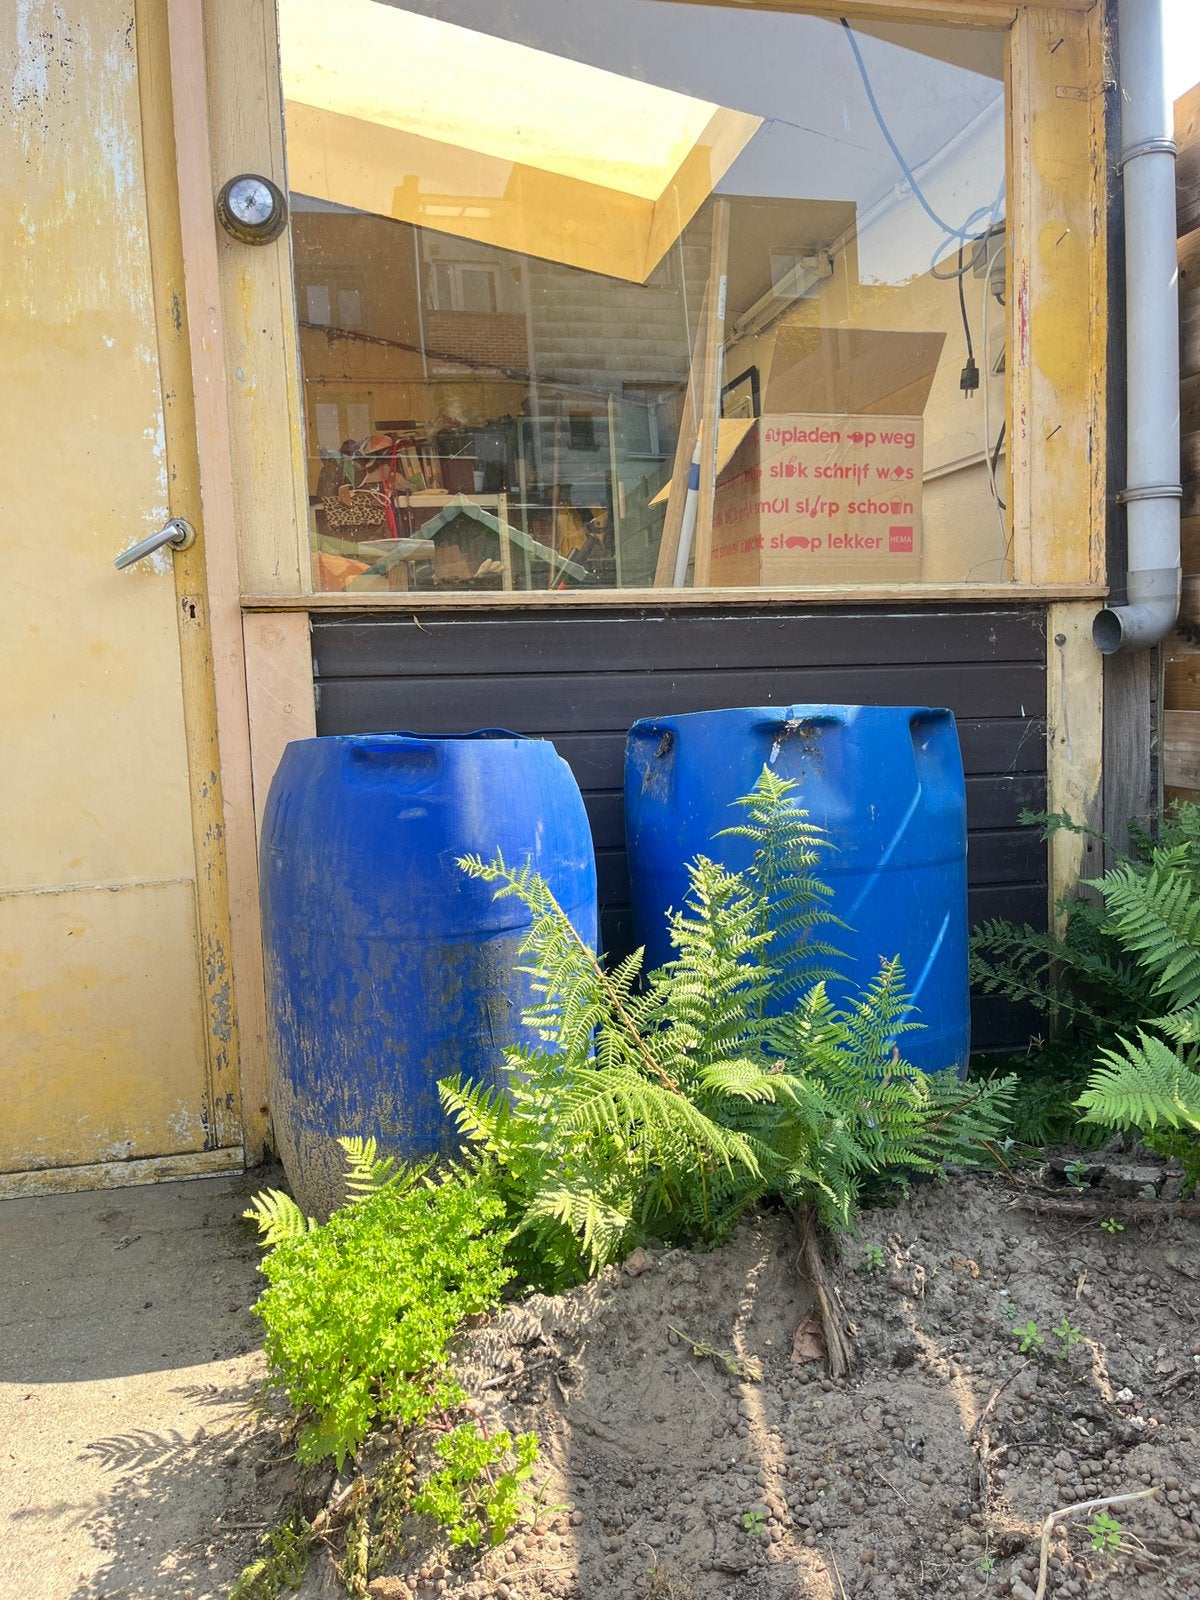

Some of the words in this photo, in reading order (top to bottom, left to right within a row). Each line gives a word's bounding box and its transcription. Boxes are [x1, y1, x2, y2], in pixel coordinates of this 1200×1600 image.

[765, 426, 841, 446] pladen
[880, 432, 915, 449] weg
[876, 465, 914, 481] ws
[796, 495, 840, 518] slrp
[770, 533, 822, 553] slp
[828, 533, 883, 549] lekker
[890, 536, 912, 544] HEMA
